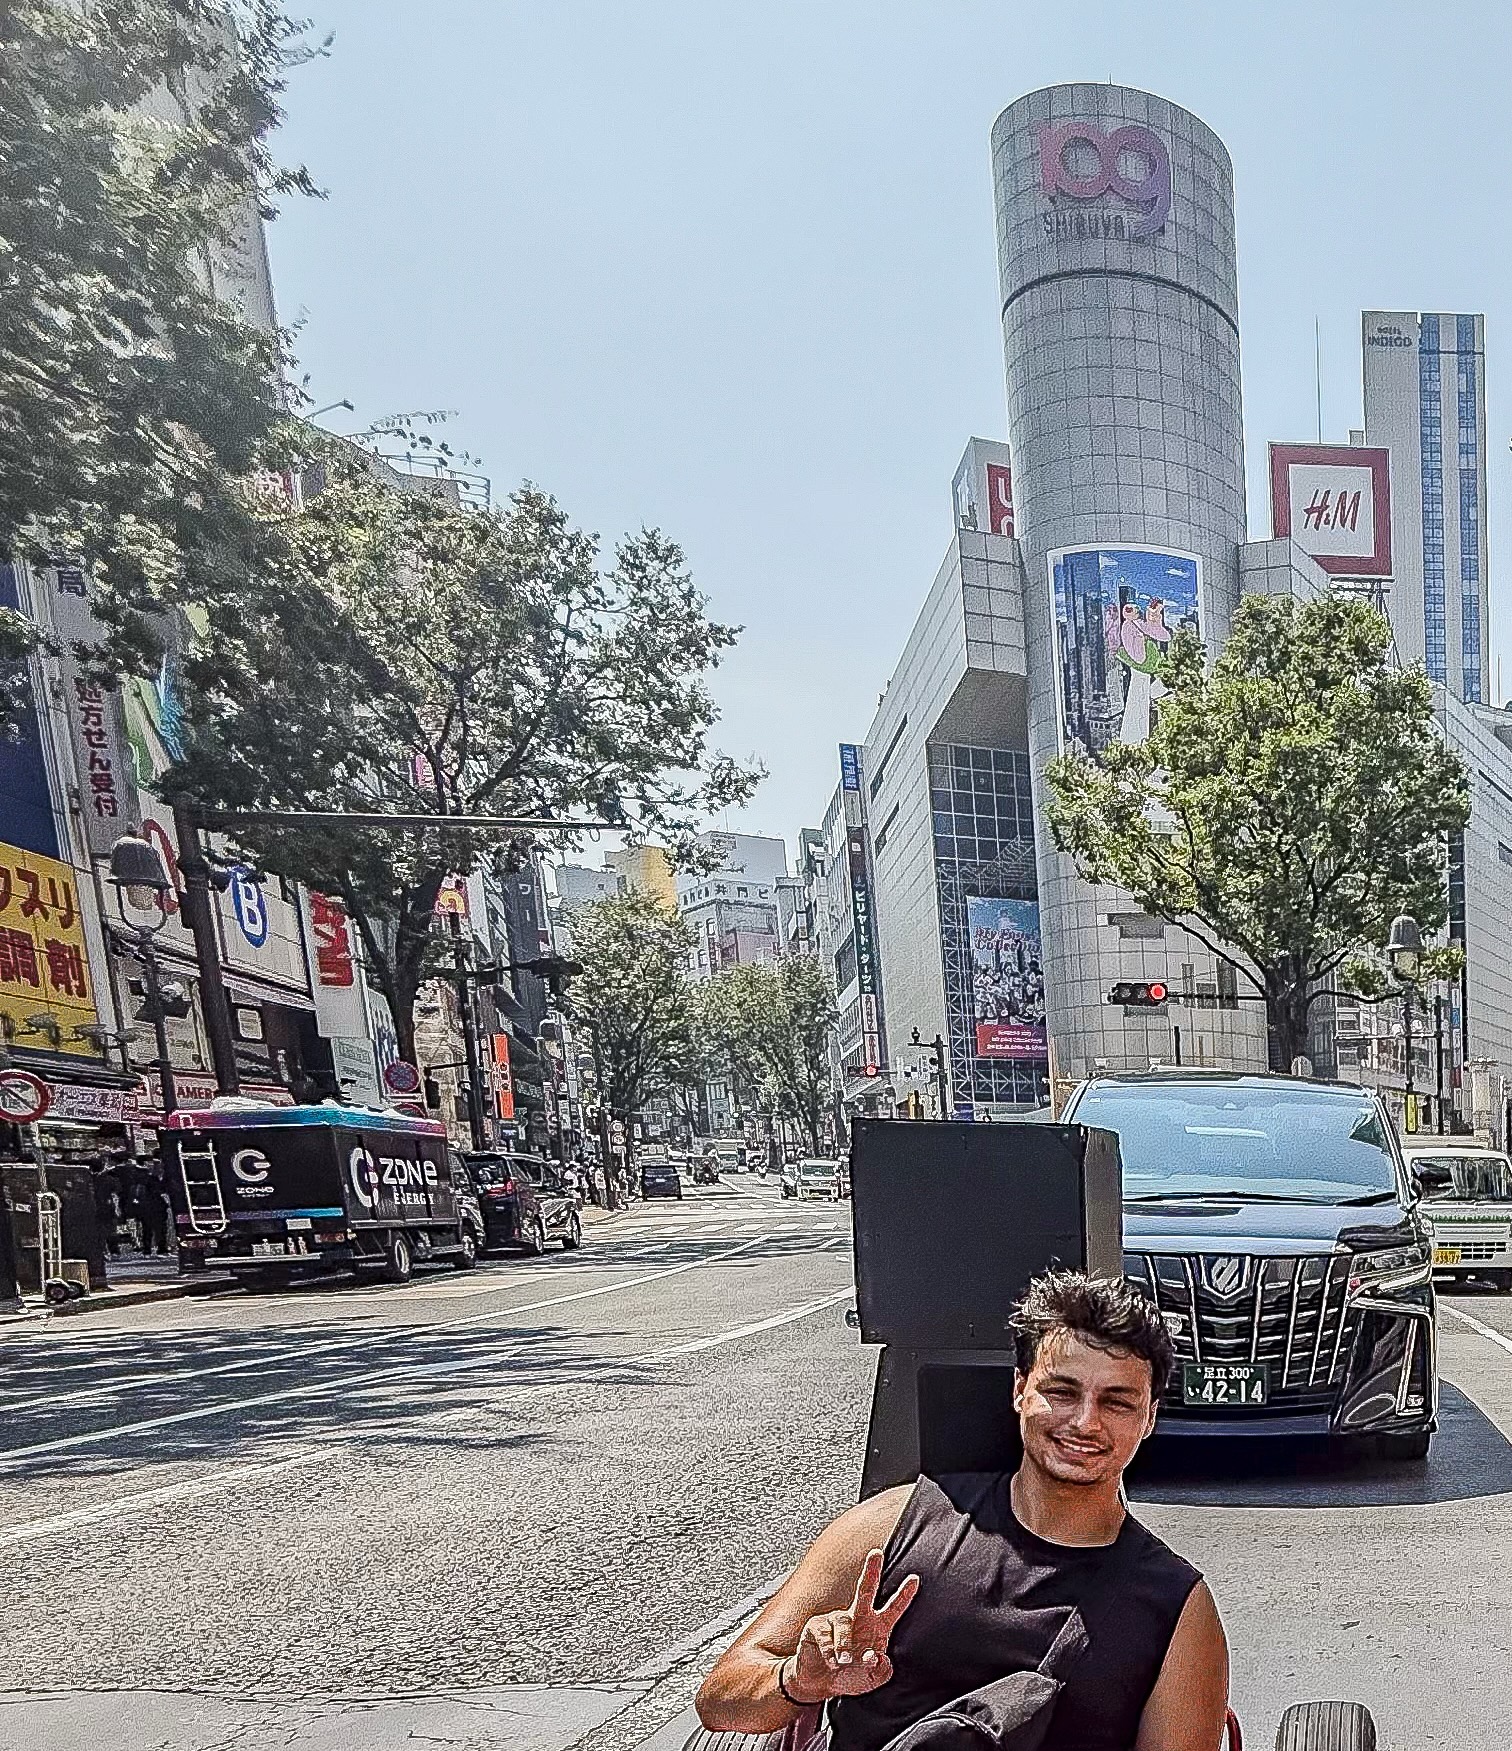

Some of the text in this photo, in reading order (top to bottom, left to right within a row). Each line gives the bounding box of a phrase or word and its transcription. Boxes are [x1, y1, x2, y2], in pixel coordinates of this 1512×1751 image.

[1367, 336, 1413, 347] INDIGO
[1303, 488, 1361, 533] H&M
[0, 926, 88, 998] 調剤
[1203, 1366, 1251, 1380] 足立 300
[1201, 1381, 1263, 1403] 42-14
